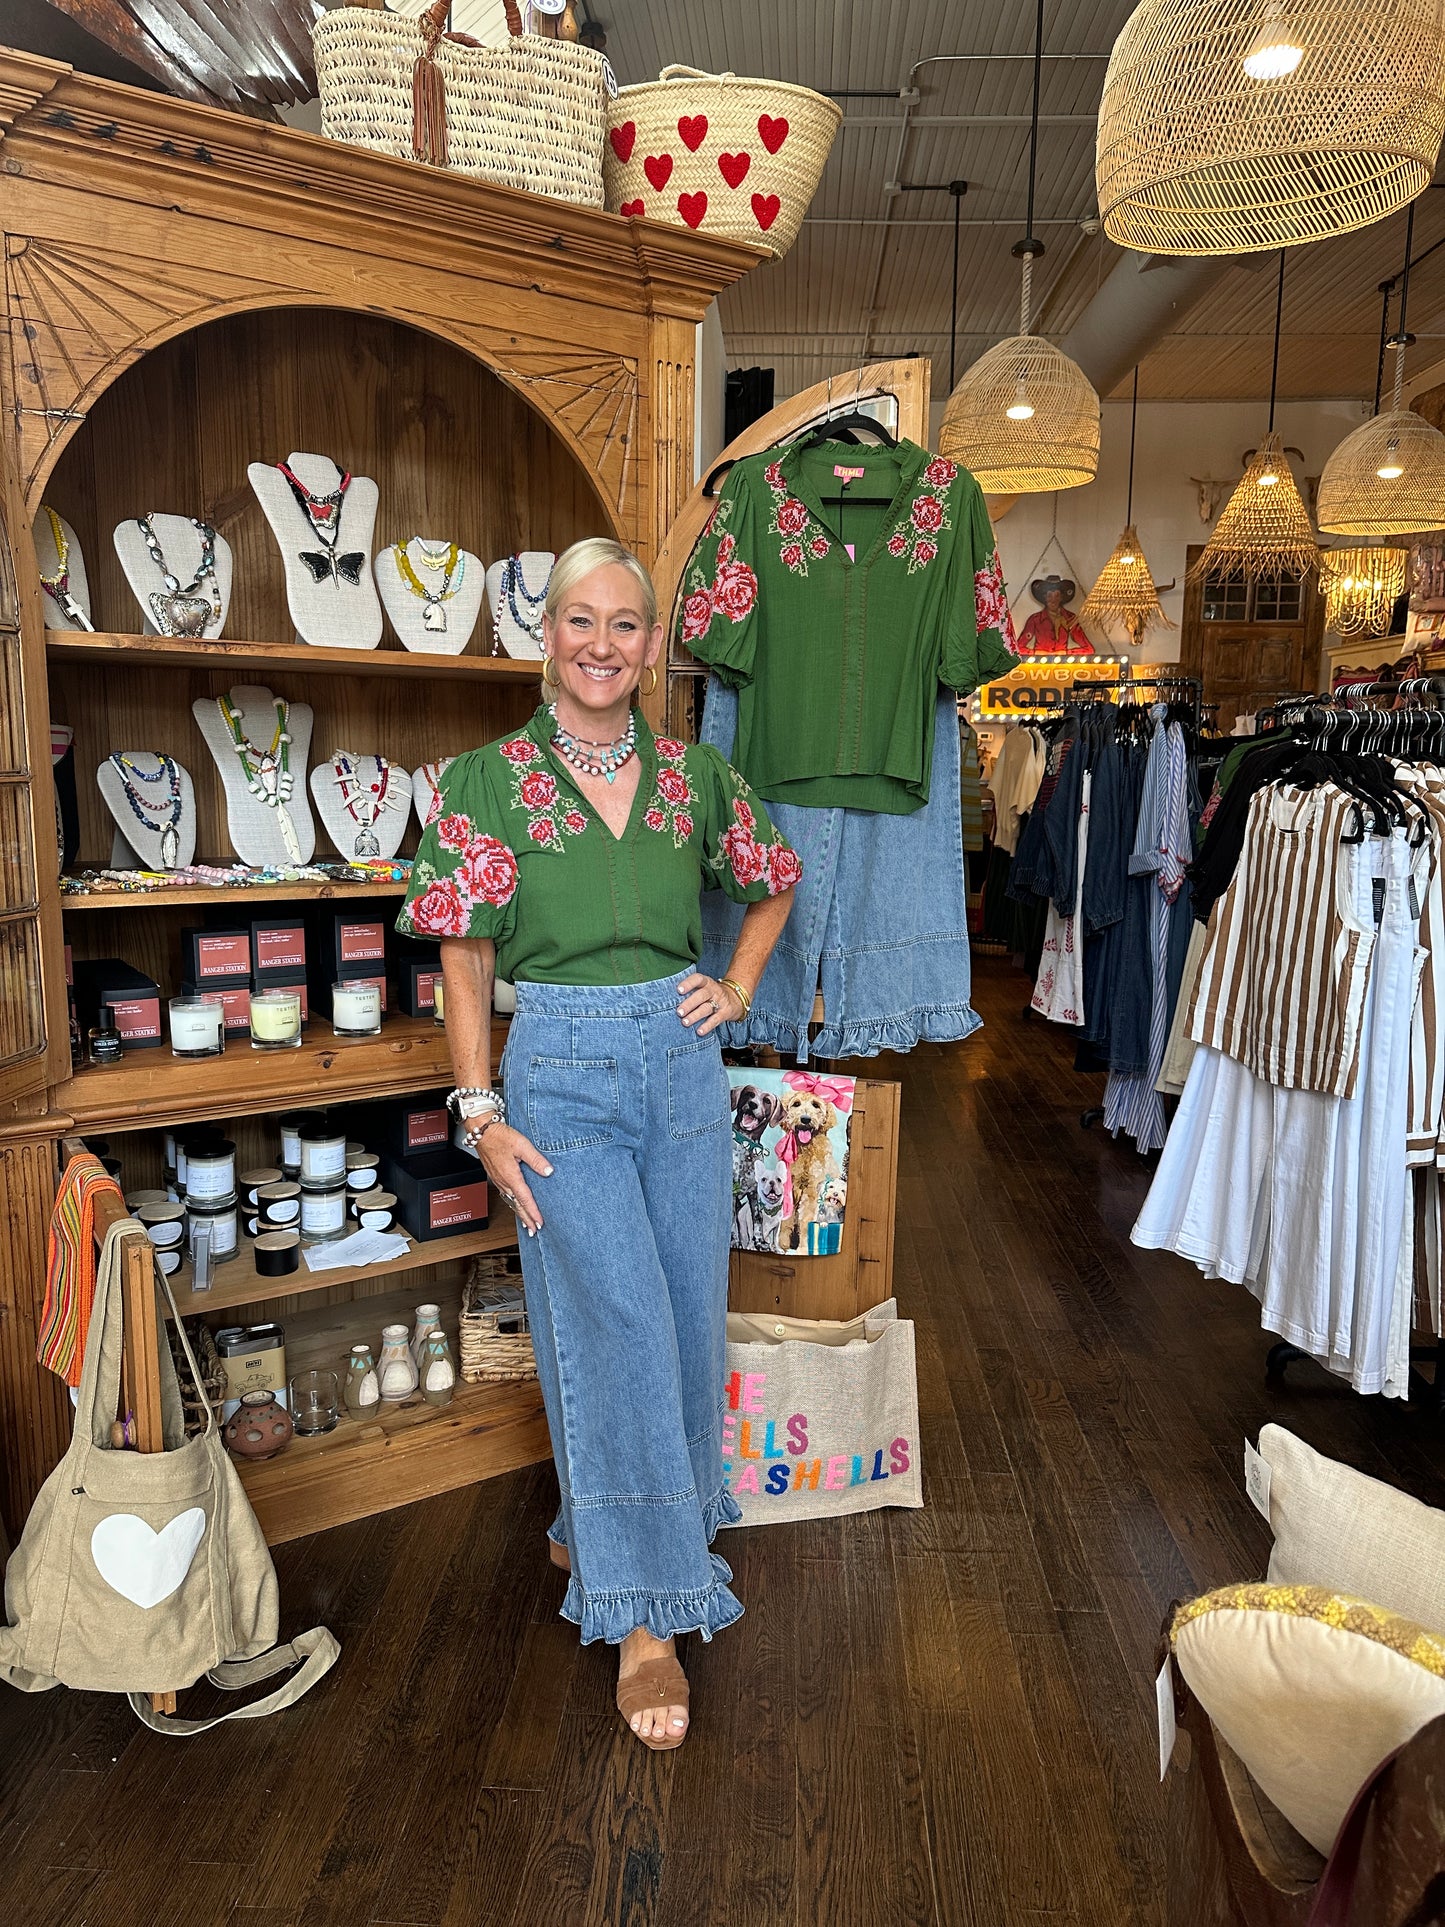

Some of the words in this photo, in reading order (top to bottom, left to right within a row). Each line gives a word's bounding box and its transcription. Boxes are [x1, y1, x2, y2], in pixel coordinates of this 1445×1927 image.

[838, 467, 861, 477] THML
[1000, 668, 1114, 682] OWBOY
[344, 951, 363, 959] RANGER
[364, 949, 382, 957] STATION
[203, 966, 225, 974] RANGER
[225, 964, 247, 972] STATION
[134, 1028, 156, 1036] STATION
[432, 1217, 452, 1226] RANGER
[453, 1213, 472, 1222] STATION
[723, 1437, 910, 1496] ASHELLS
